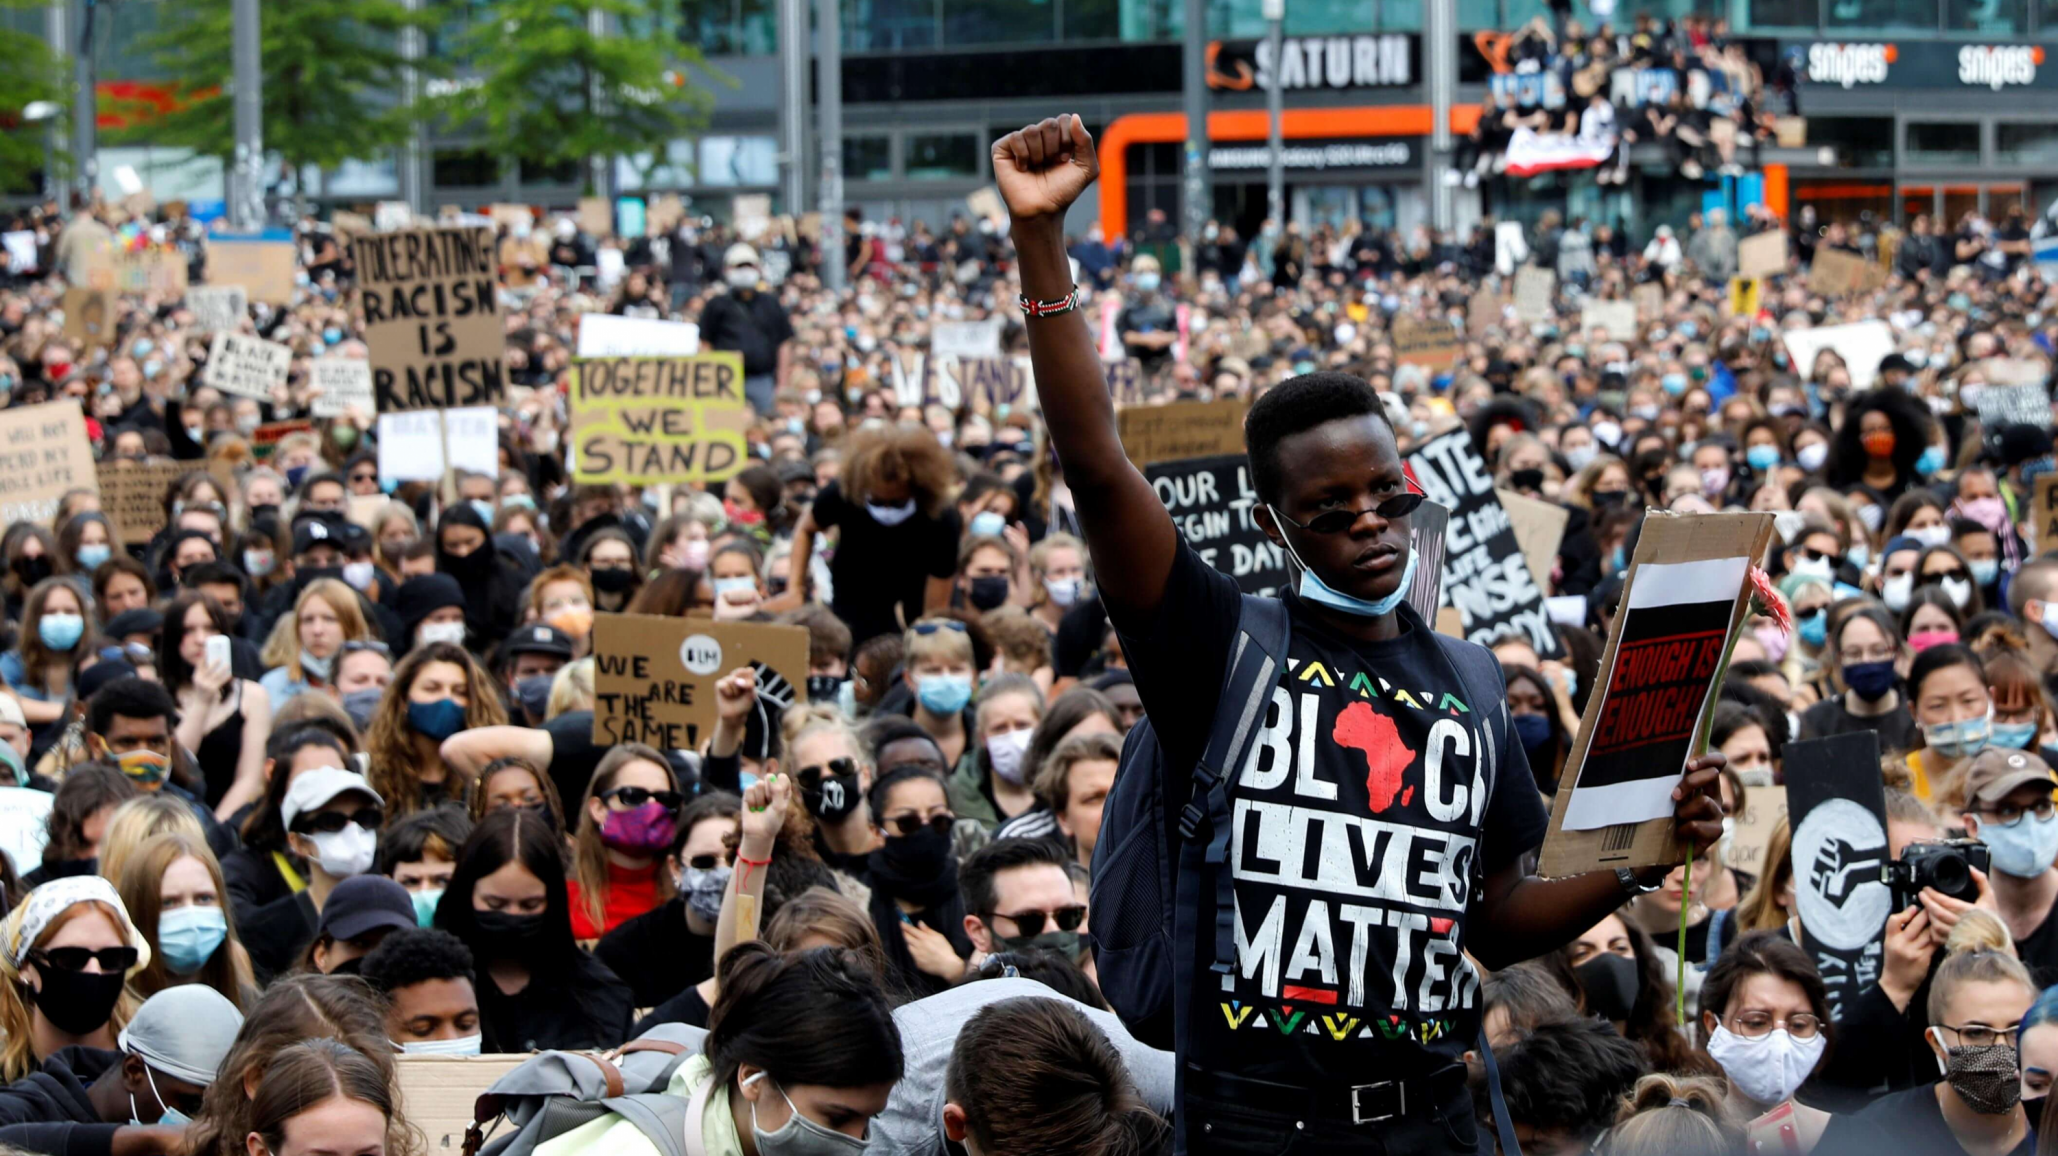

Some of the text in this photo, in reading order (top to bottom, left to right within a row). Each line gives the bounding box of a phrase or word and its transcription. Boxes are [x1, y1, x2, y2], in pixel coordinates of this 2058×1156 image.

[1255, 34, 1409, 90] SATURN
[1808, 42, 1888, 90] snipes
[1958, 44, 2037, 92] snipes
[355, 228, 496, 284] TOLERATING
[362, 280, 497, 325] RACISM
[419, 322, 456, 358] IS
[374, 359, 507, 413] RACISM
[573, 358, 738, 403] TOGETHER
[621, 408, 690, 436] WE
[581, 436, 737, 475] STAND
[1409, 429, 1493, 513] ATE
[1152, 465, 1257, 512] OUR L
[1174, 509, 1231, 543] EGIN
[1230, 540, 1285, 577] DAY
[1448, 551, 1541, 629] NSE
[597, 653, 650, 680] WE
[1610, 636, 1721, 693] ENOUGH IS
[597, 692, 656, 723] THE
[649, 678, 696, 706] ARE
[602, 716, 699, 751] SAME!
[1596, 683, 1706, 748] ENOUGH!
[1236, 803, 1475, 909] LIVES
